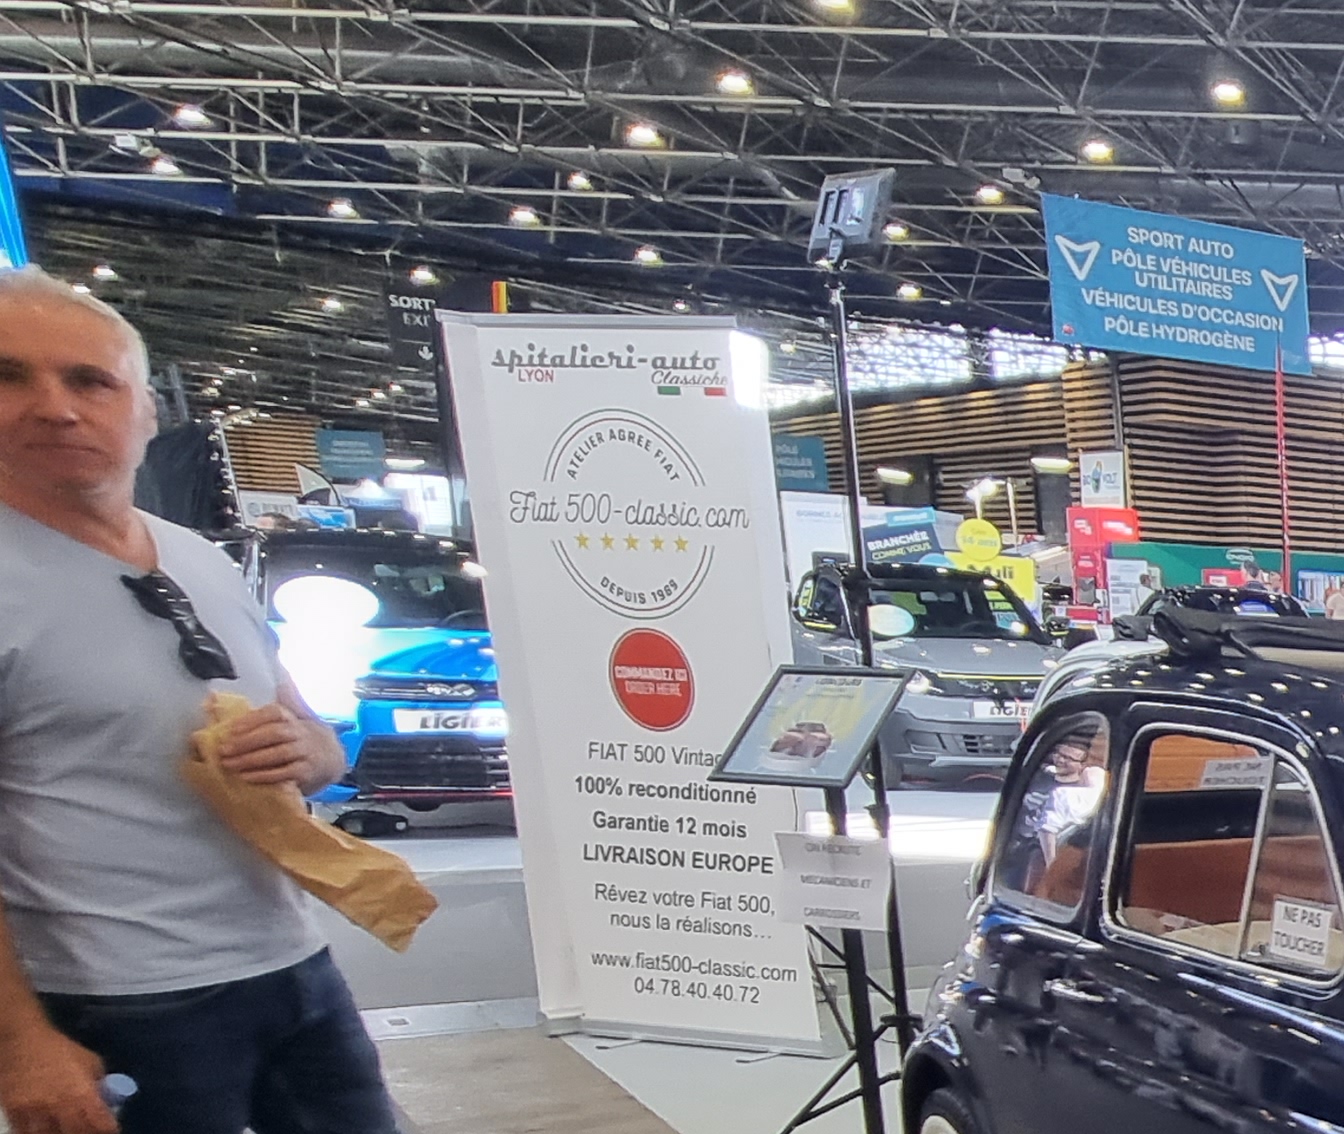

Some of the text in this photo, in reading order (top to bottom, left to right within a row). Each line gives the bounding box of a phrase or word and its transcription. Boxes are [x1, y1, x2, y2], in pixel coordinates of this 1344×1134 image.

[1127, 226, 1234, 259] SPORT AUTO
[1111, 248, 1252, 286] PÔLE VÉHICULES
[1135, 271, 1233, 301] UTILITAIRES
[389, 295, 433, 311] SORT
[1081, 287, 1283, 333] VÉHICULES D'OCCASION
[403, 313, 430, 327] EXI
[1104, 314, 1255, 353] PÔLE HYDROGÈNE
[491, 343, 720, 372] spitalieri-auto
[517, 369, 555, 383] LYON
[651, 369, 727, 385] Classiche
[567, 428, 680, 482] ATELIER AGREE FIAT
[509, 491, 560, 523] Fiat
[600, 576, 646, 604] DEPUIS
[588, 741, 723, 768] FIAT 500 Vintag
[575, 776, 757, 805] 100% reconditionné
[593, 811, 747, 838] Garantie 12 mois
[583, 844, 774, 875] LIVRAISON EUROPE
[595, 883, 776, 916] Rêvez votre Fiat 500,
[610, 914, 651, 930] nous
[656, 914, 671, 932] la
[1283, 905, 1321, 928] NE PAS
[1274, 931, 1325, 956] TOUCHER
[591, 953, 798, 983] www.fiat500-classic.com
[635, 977, 760, 1004] 04.78.40.40.72
